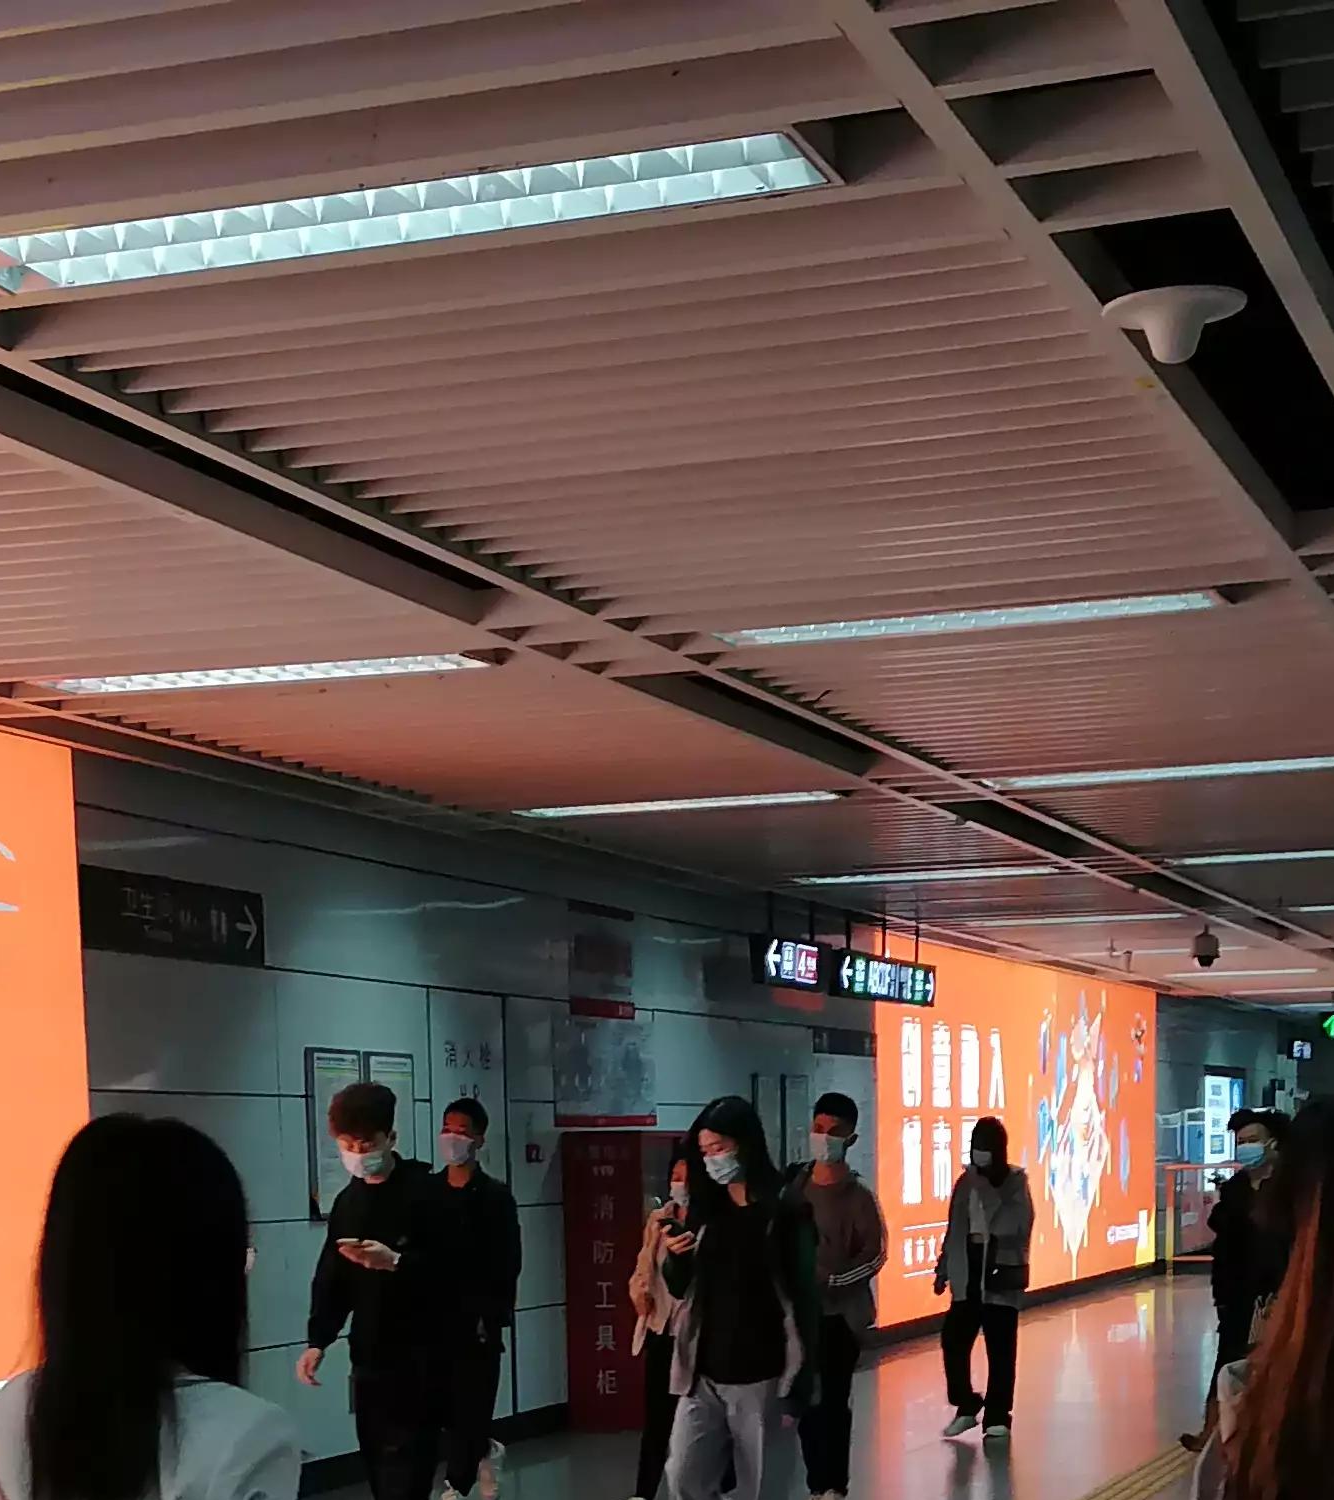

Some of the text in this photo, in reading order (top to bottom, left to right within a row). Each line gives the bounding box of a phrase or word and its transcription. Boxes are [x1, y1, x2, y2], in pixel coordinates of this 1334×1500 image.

[592, 1195, 618, 1395] 消防工具柜
